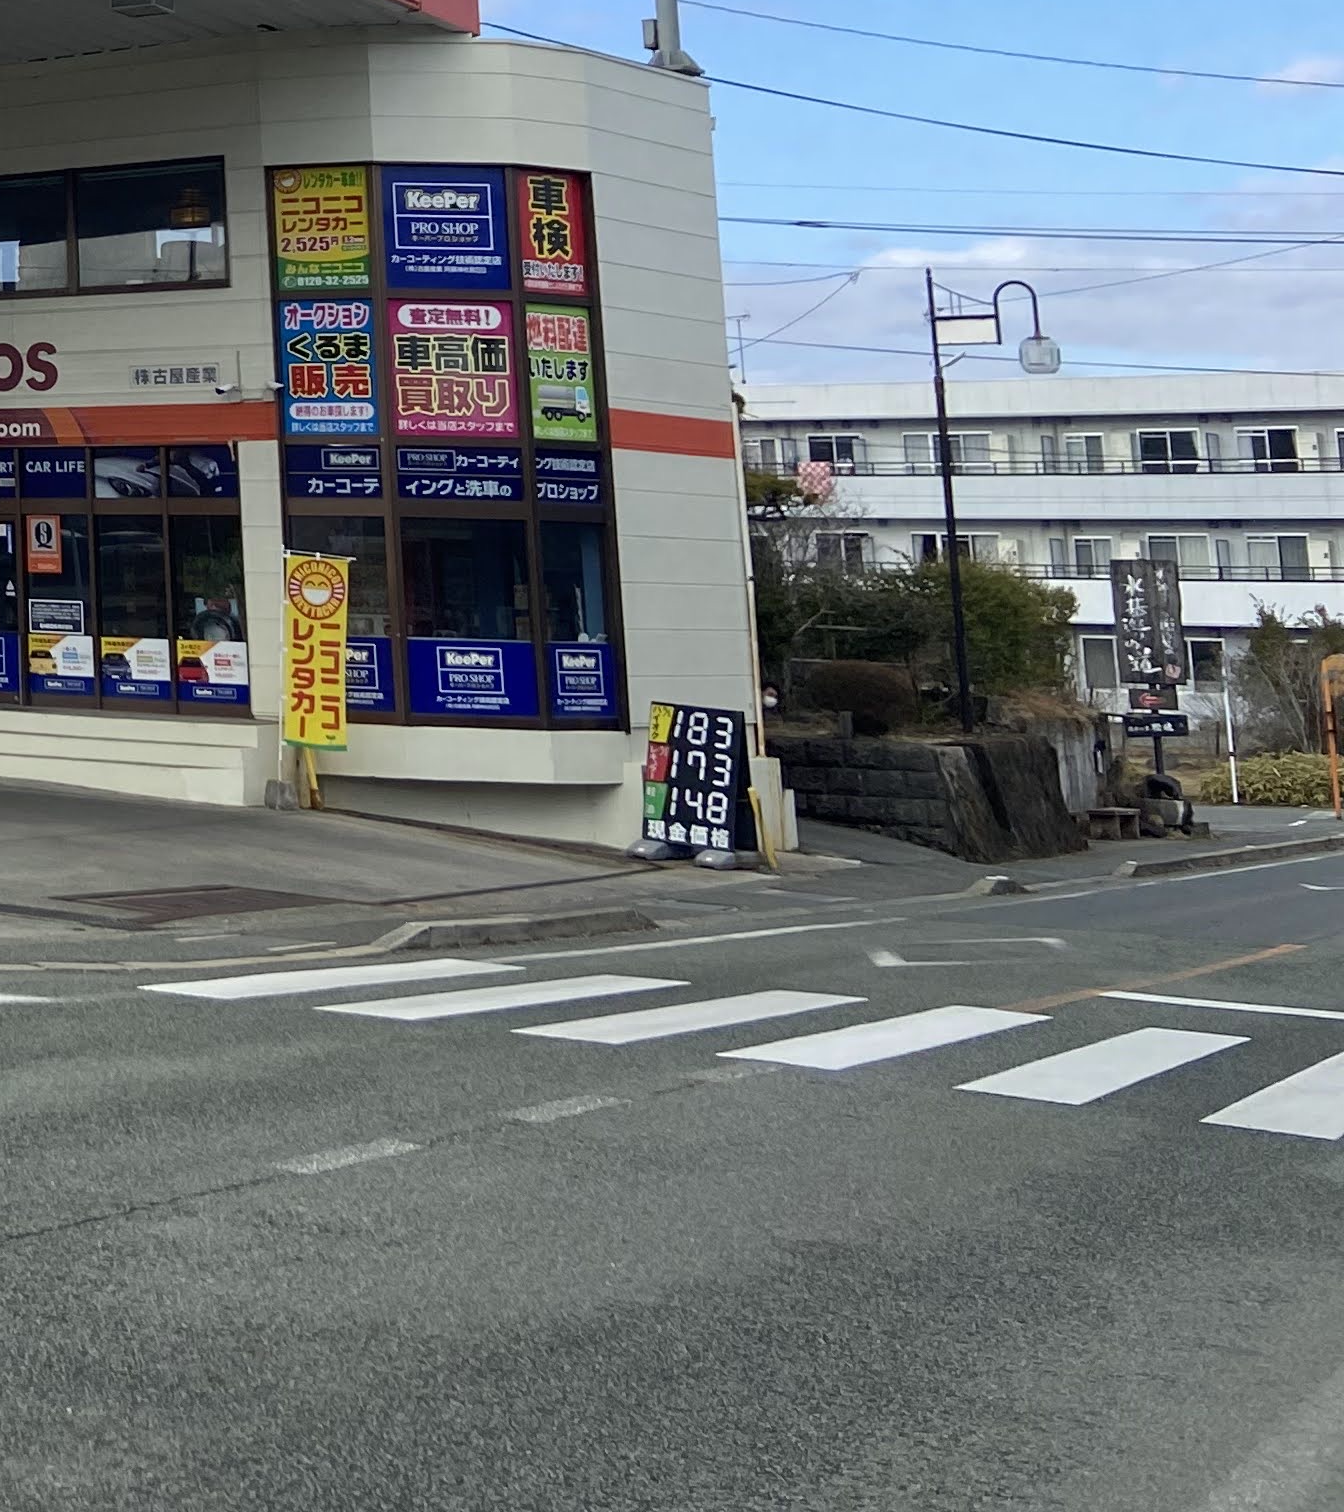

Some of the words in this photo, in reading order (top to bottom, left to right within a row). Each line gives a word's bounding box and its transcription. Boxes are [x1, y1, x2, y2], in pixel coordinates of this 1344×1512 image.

[281, 196, 363, 215] ニコニコ
[405, 189, 480, 210] KeePer
[282, 216, 363, 233] レンタカー
[411, 222, 439, 234] PRO
[442, 222, 478, 235] SHOP
[528, 176, 572, 259] 車検
[285, 303, 369, 329] オークション
[287, 332, 370, 361] くるま
[394, 333, 510, 374] 車高価
[289, 362, 371, 398] 販売
[529, 356, 589, 382] いたします
[396, 374, 510, 417] 買取り
[26, 461, 51, 473] CAR
[56, 461, 85, 473] LIFE
[329, 454, 371, 465] KeePer
[456, 456, 519, 469] カーコーティ
[308, 478, 379, 494] カーコーテ
[536, 483, 598, 501] プロショップ
[346, 648, 368, 662] Per
[445, 651, 494, 666] KeePer
[562, 655, 596, 669] KeePer
[290, 618, 315, 738] レンタカー
[319, 623, 341, 730] ニコニコ
[448, 673, 468, 683] PRO
[469, 674, 495, 683] SHOP
[674, 710, 733, 749] 183
[670, 750, 732, 787] 173
[670, 787, 728, 825] 148
